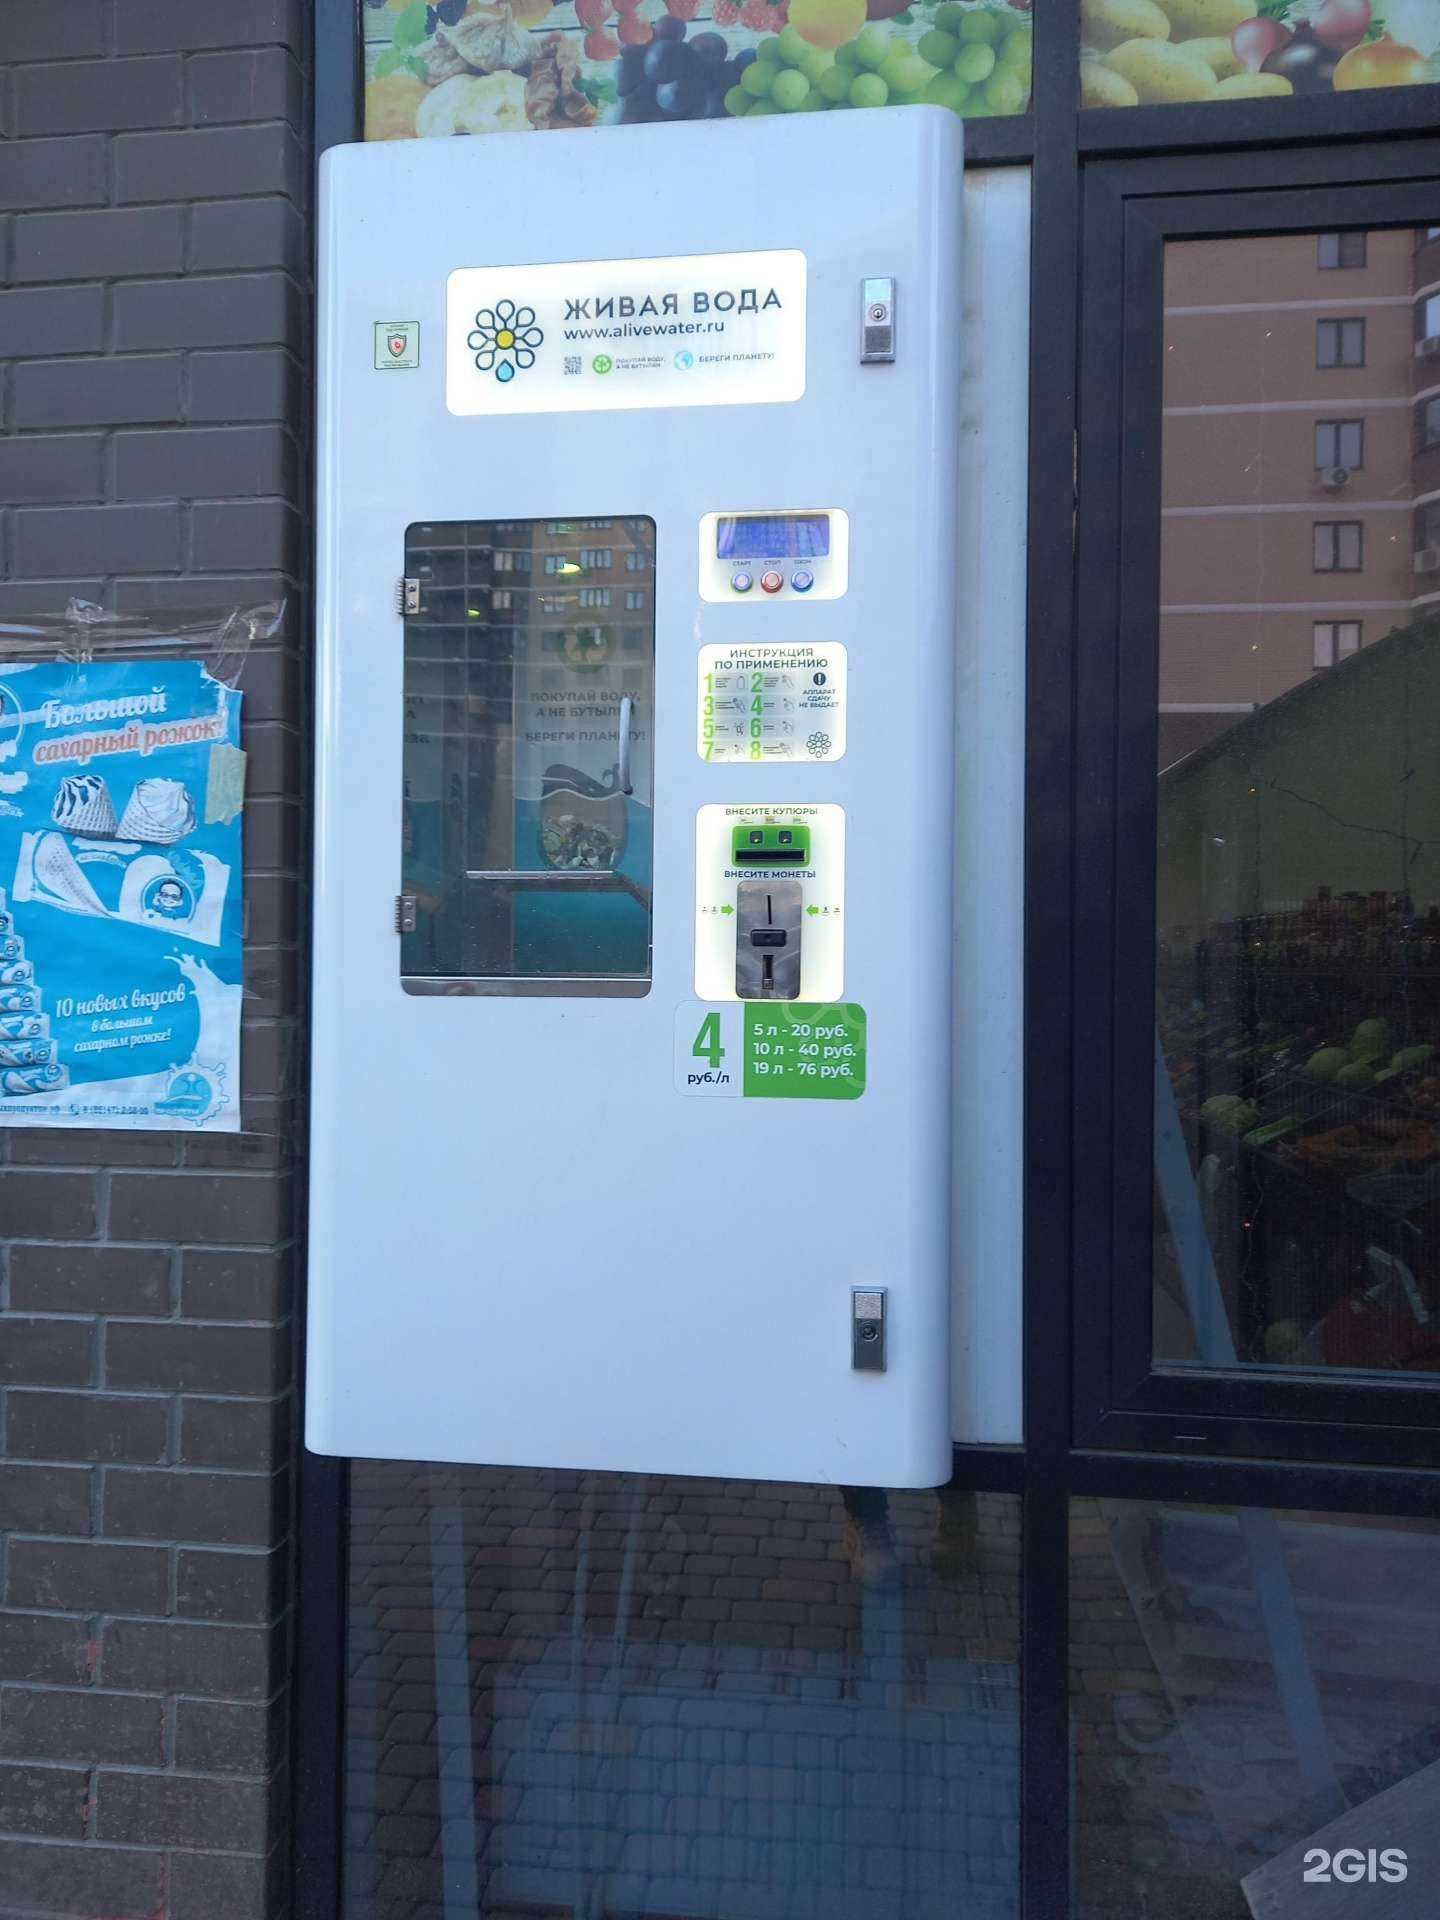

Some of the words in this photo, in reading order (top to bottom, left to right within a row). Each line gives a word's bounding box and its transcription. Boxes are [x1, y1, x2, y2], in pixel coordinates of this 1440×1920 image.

[563, 293, 679, 321] ЖИВАЯ
[692, 288, 782, 315] ВОДА
[563, 320, 725, 340] www.alivewater.ru
[699, 354, 731, 363] БЕРЕГИ
[730, 648, 813, 658] ИНСТРУКЦИЯ
[715, 660, 732, 669] ПО
[736, 659, 828, 669] ПРИМЕНЕНИЮ
[704, 673, 713, 693] 1
[751, 672, 763, 692] 2
[530, 690, 596, 702] ПОКУПАЙ
[750, 696, 763, 715] 4
[41, 684, 167, 728] Большой
[536, 707, 545, 716] А
[548, 707, 566, 716] НЕ
[704, 696, 714, 716] 3
[525, 730, 575, 741] БЕРЕГИ
[703, 718, 714, 738] 5
[750, 718, 761, 738] 6
[35, 727, 138, 762] сахарный
[703, 741, 714, 761] 7
[750, 741, 761, 760] 8
[772, 807, 818, 815] КУПЮРЫ
[771, 870, 816, 878] МОНЕТЫ
[56, 998, 73, 1018] 10
[76, 994, 128, 1016] новых
[132, 983, 186, 1011] вкусов
[91, 1019, 99, 1032] в
[101, 1016, 152, 1031] большом
[753, 1023, 763, 1036] 5
[766, 1026, 777, 1036] л
[791, 1024, 811, 1036] 20
[815, 1025, 848, 1040] руб.
[74, 1036, 128, 1053] сахарном
[131, 1028, 172, 1048] рожке!
[692, 1012, 725, 1068] 4
[753, 1043, 770, 1055] 10
[773, 1045, 784, 1055] л
[798, 1043, 819, 1056] 40
[823, 1044, 856, 1060] руб.
[687, 1071, 730, 1085] руб./л
[753, 1062, 769, 1074] 19
[772, 1064, 783, 1075] л
[797, 1063, 817, 1075] 76
[820, 1064, 854, 1079] руб.
